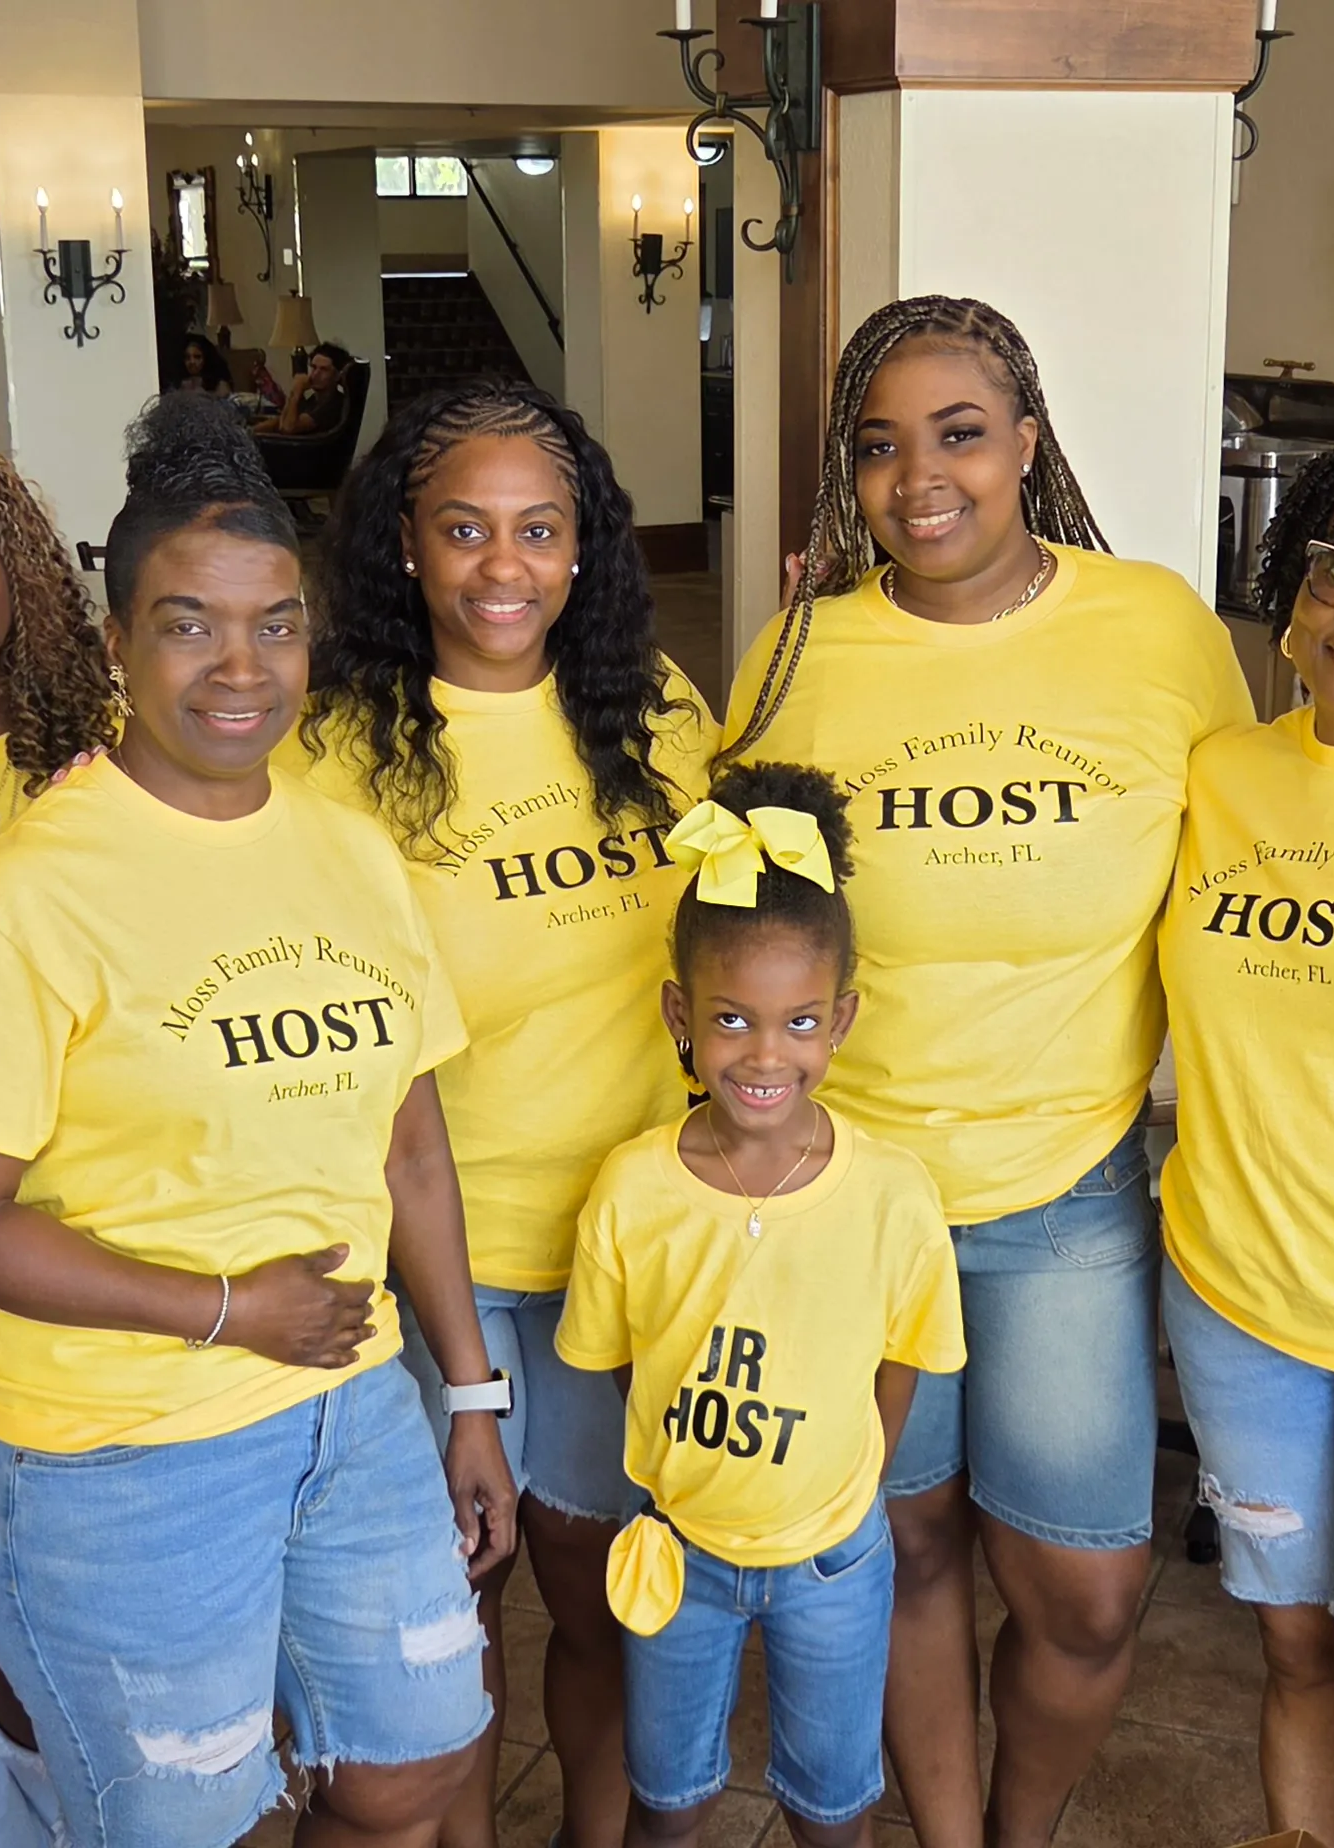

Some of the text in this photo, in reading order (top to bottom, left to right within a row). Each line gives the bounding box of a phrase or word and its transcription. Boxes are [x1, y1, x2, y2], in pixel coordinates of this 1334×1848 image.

[842, 722, 1127, 799] Moss Family Reunion
[435, 782, 581, 878] Moss Family
[876, 780, 1087, 830] HOST
[483, 824, 675, 900] HOST
[924, 844, 1042, 866] Archer, FL
[1187, 859, 1248, 904] Moss
[547, 892, 650, 928] Archer, FL
[160, 935, 416, 1043] Moss Family Reunion
[1237, 957, 1332, 984] Archer, FL
[211, 997, 394, 1069] HOST
[267, 1071, 359, 1103] Archer, FL
[697, 1324, 767, 1393] JR
[663, 1386, 807, 1466] HOST
